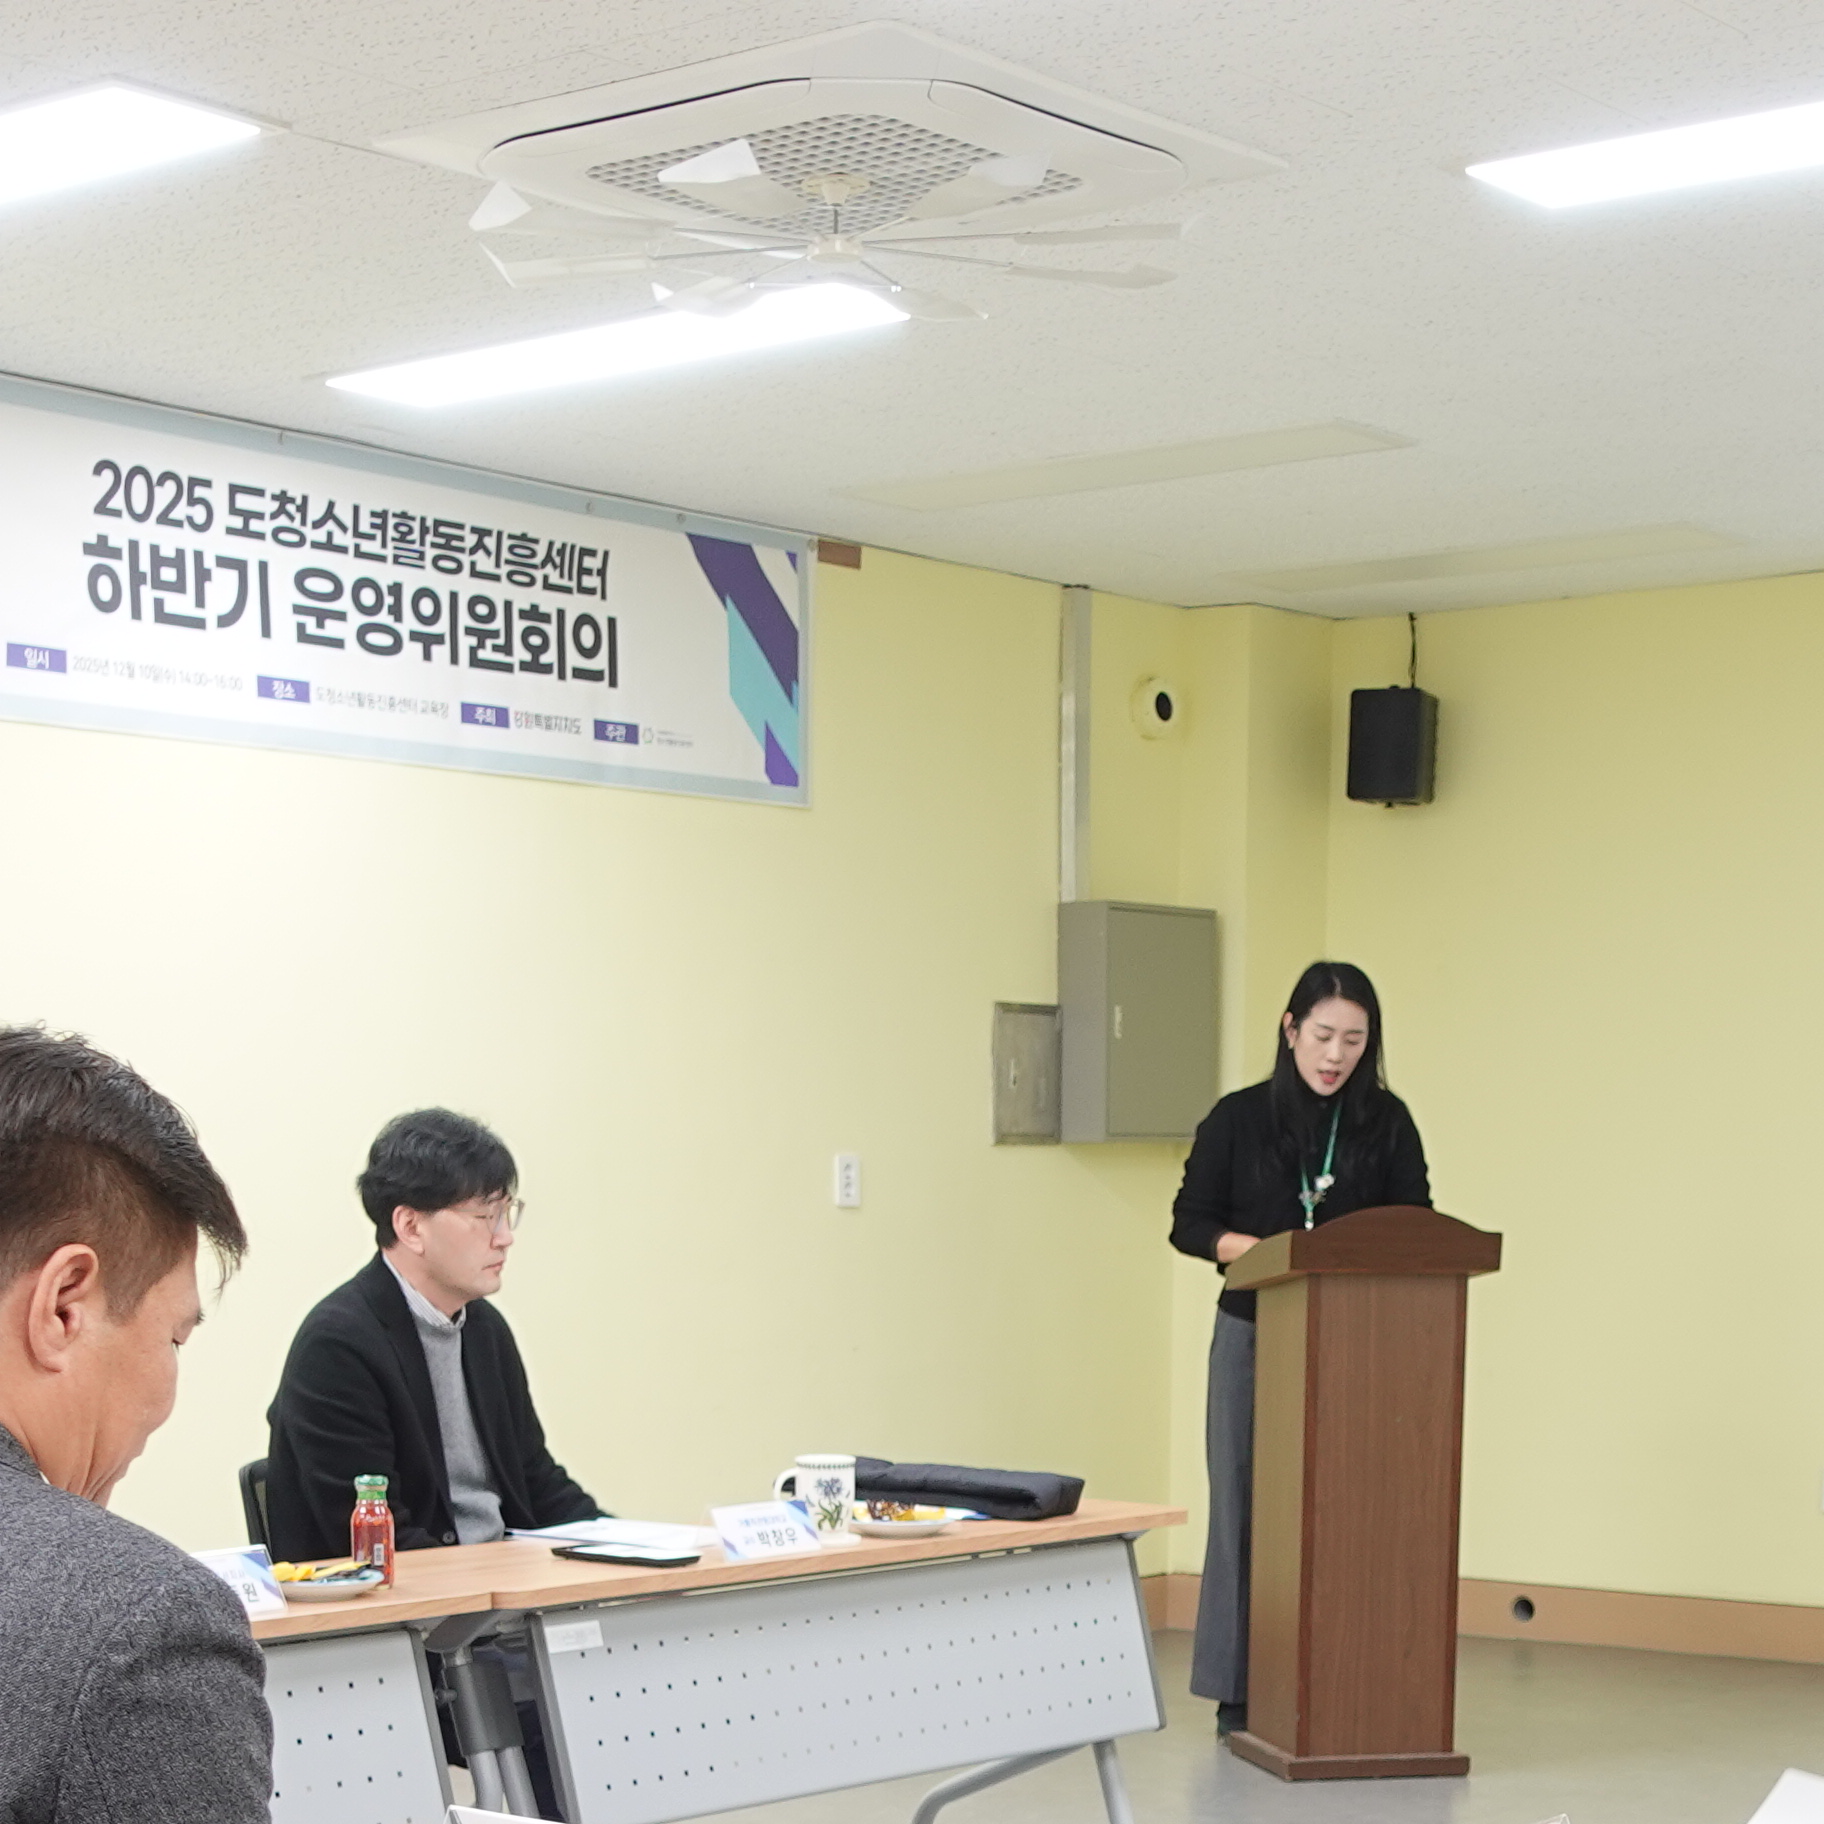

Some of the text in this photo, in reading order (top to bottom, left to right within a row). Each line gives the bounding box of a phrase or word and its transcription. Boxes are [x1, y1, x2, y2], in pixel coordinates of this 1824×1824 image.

[92, 459, 610, 601] 2025 도청소년활동진흥센터
[24, 648, 50, 670] 일시
[82, 533, 619, 688] 하반기 운영위원회의
